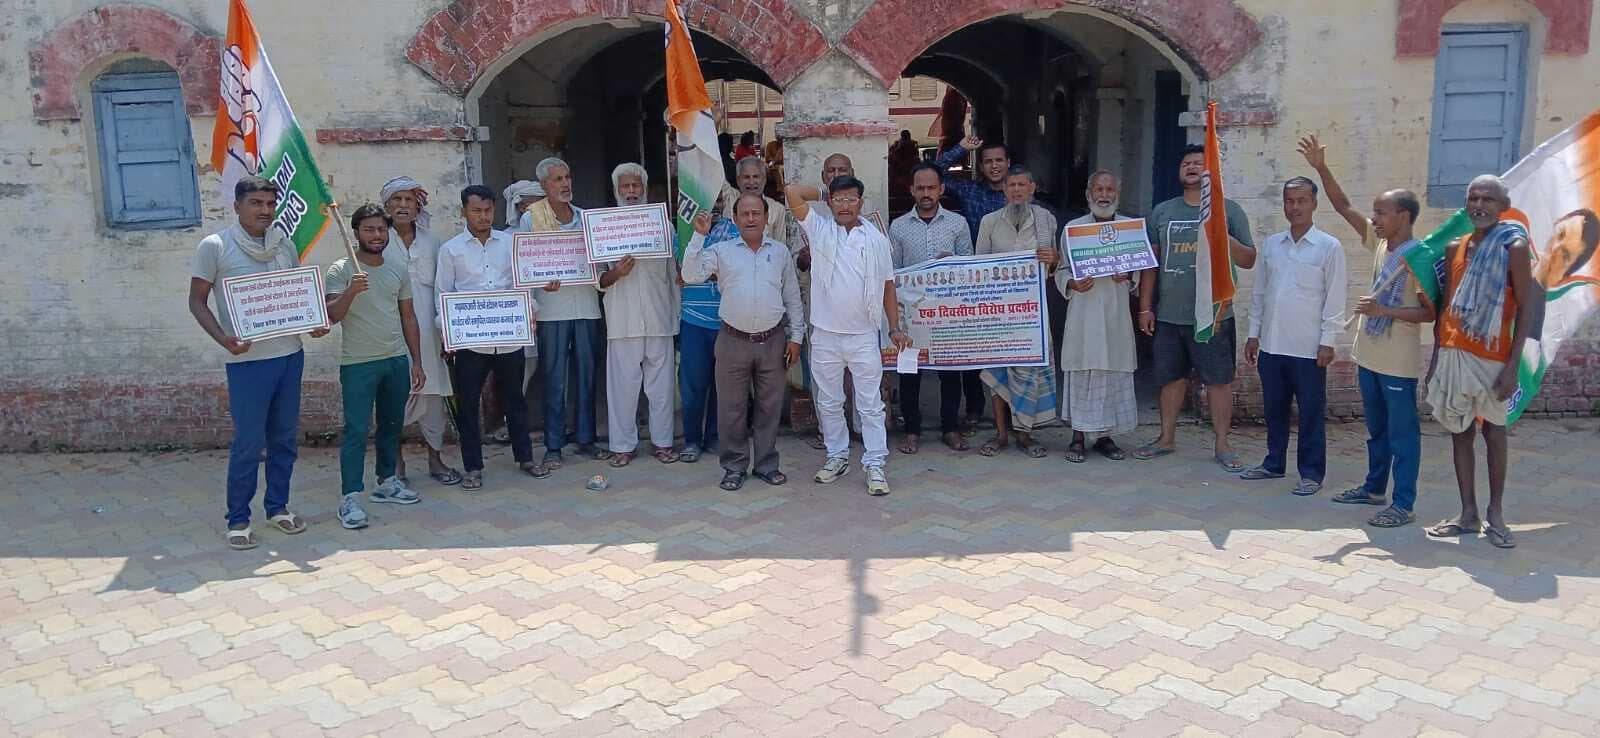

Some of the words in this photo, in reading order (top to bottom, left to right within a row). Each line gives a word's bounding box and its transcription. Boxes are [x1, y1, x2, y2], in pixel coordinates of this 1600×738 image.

[1073, 249, 1094, 257] INDIAN
[1095, 246, 1114, 255] YOUTH
[920, 308, 936, 318] एक
[939, 304, 976, 317] दिवसीय
[978, 302, 1005, 315] विरोध
[1007, 299, 1039, 313] प्रदर्शन
